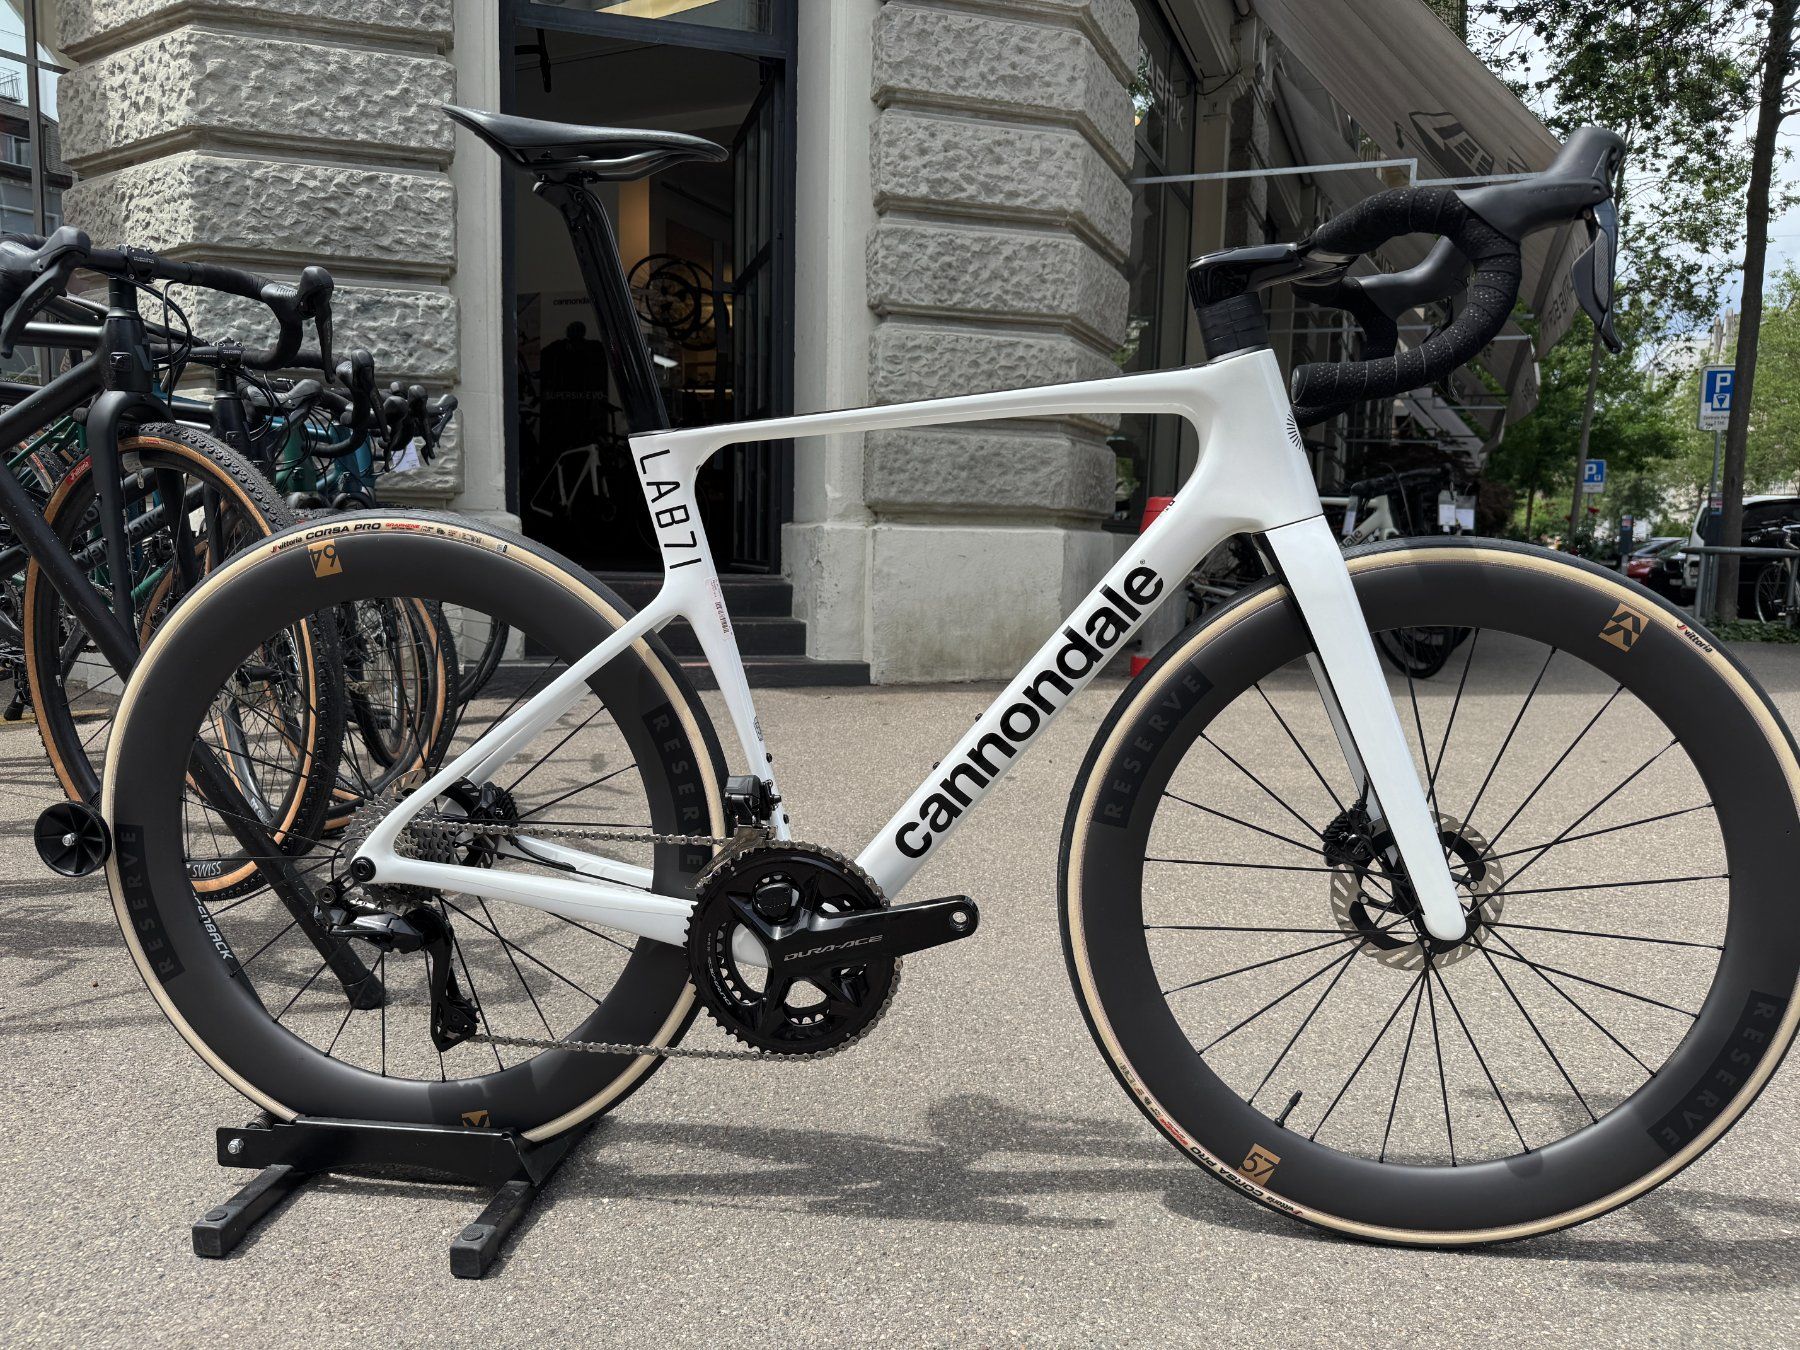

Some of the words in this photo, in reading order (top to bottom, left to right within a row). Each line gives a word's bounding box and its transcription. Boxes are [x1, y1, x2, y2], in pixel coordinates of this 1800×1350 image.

[1715, 372, 1731, 393] P
[1584, 464, 1597, 481] P
[639, 448, 702, 570] LAB71
[278, 537, 303, 550] vittoria
[305, 525, 351, 540] CORSA
[353, 522, 382, 532] PRO
[1684, 629, 1713, 653] vittoria
[895, 566, 1164, 858] cannondale
[1103, 674, 1201, 819] RESERVE
[192, 860, 222, 878] SWISS
[120, 831, 175, 976] RESERVE
[783, 934, 884, 962] DURA-ACE
[1660, 1001, 1778, 1146] RESERVE
[1190, 1146, 1219, 1168] PRO
[1241, 1151, 1279, 1178] 57
[1218, 1168, 1264, 1197] CORSA
